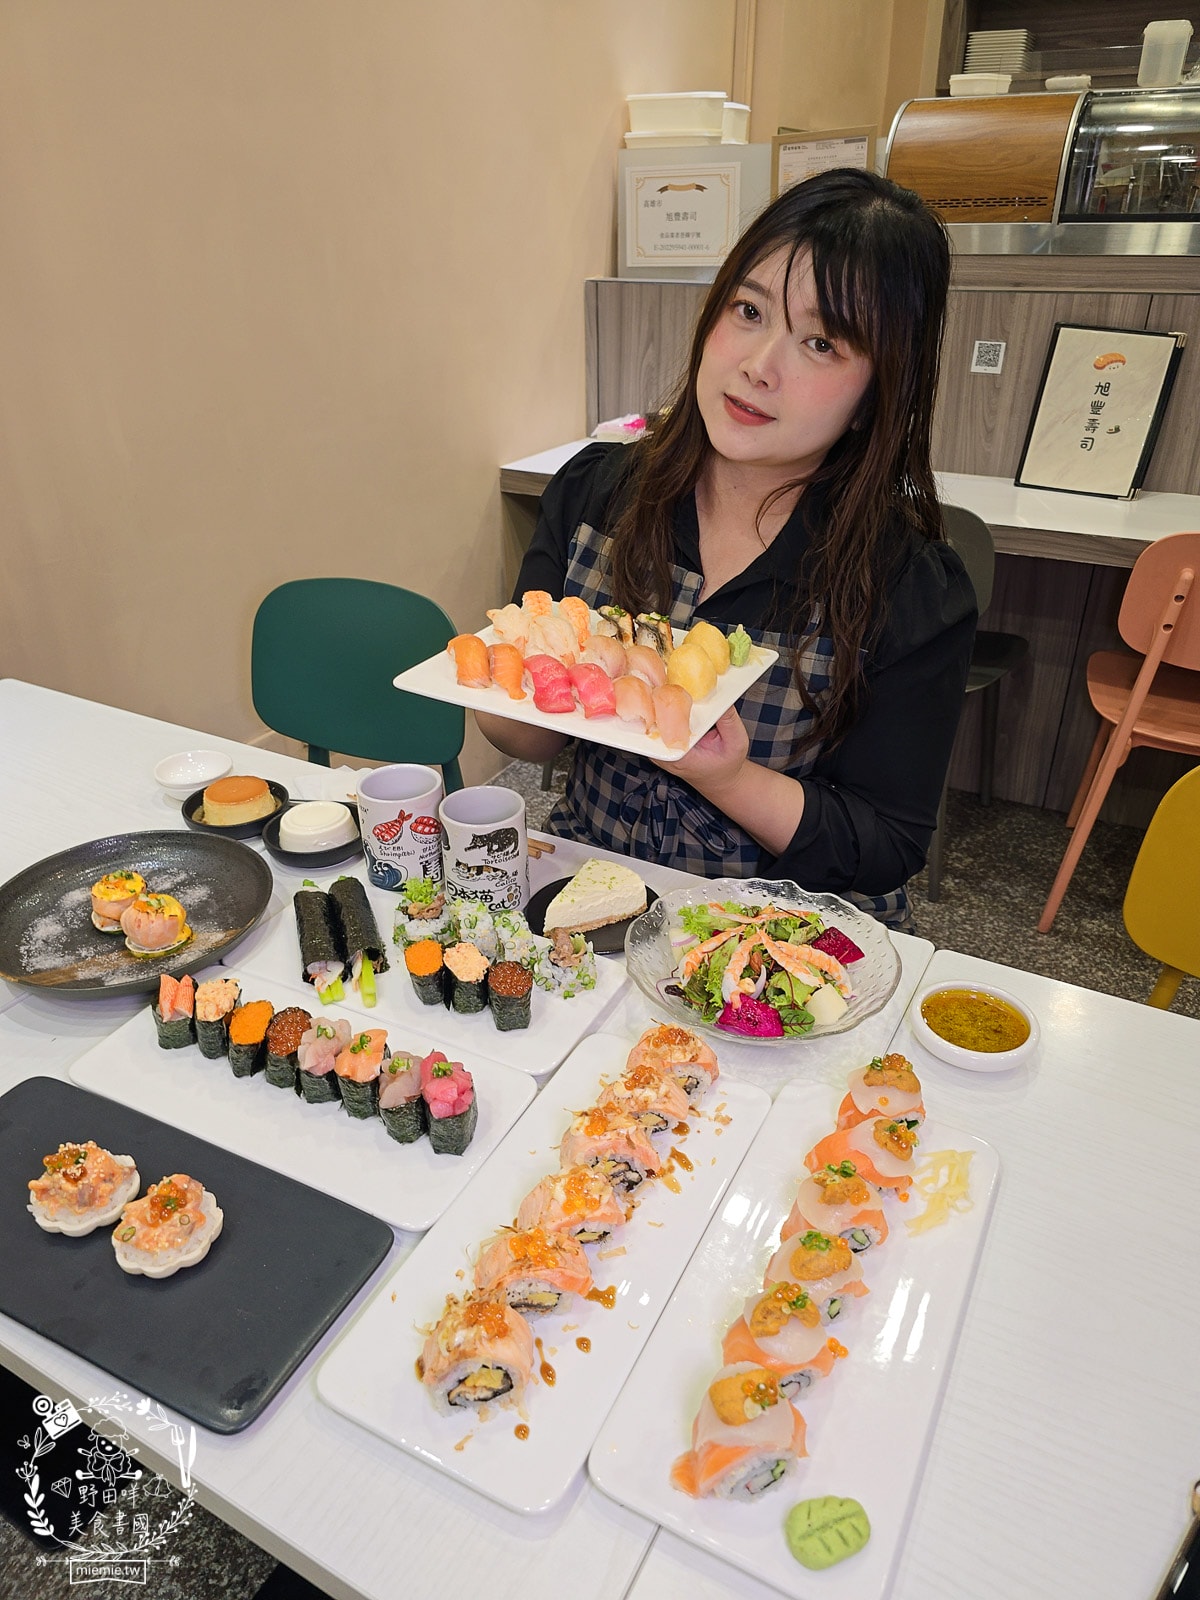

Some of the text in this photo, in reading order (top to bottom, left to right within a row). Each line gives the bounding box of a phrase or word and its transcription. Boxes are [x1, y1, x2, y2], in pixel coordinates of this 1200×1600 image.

[666, 211, 698, 222] 旭豐壽司
[1080, 381, 1111, 452] 旭豐壽司
